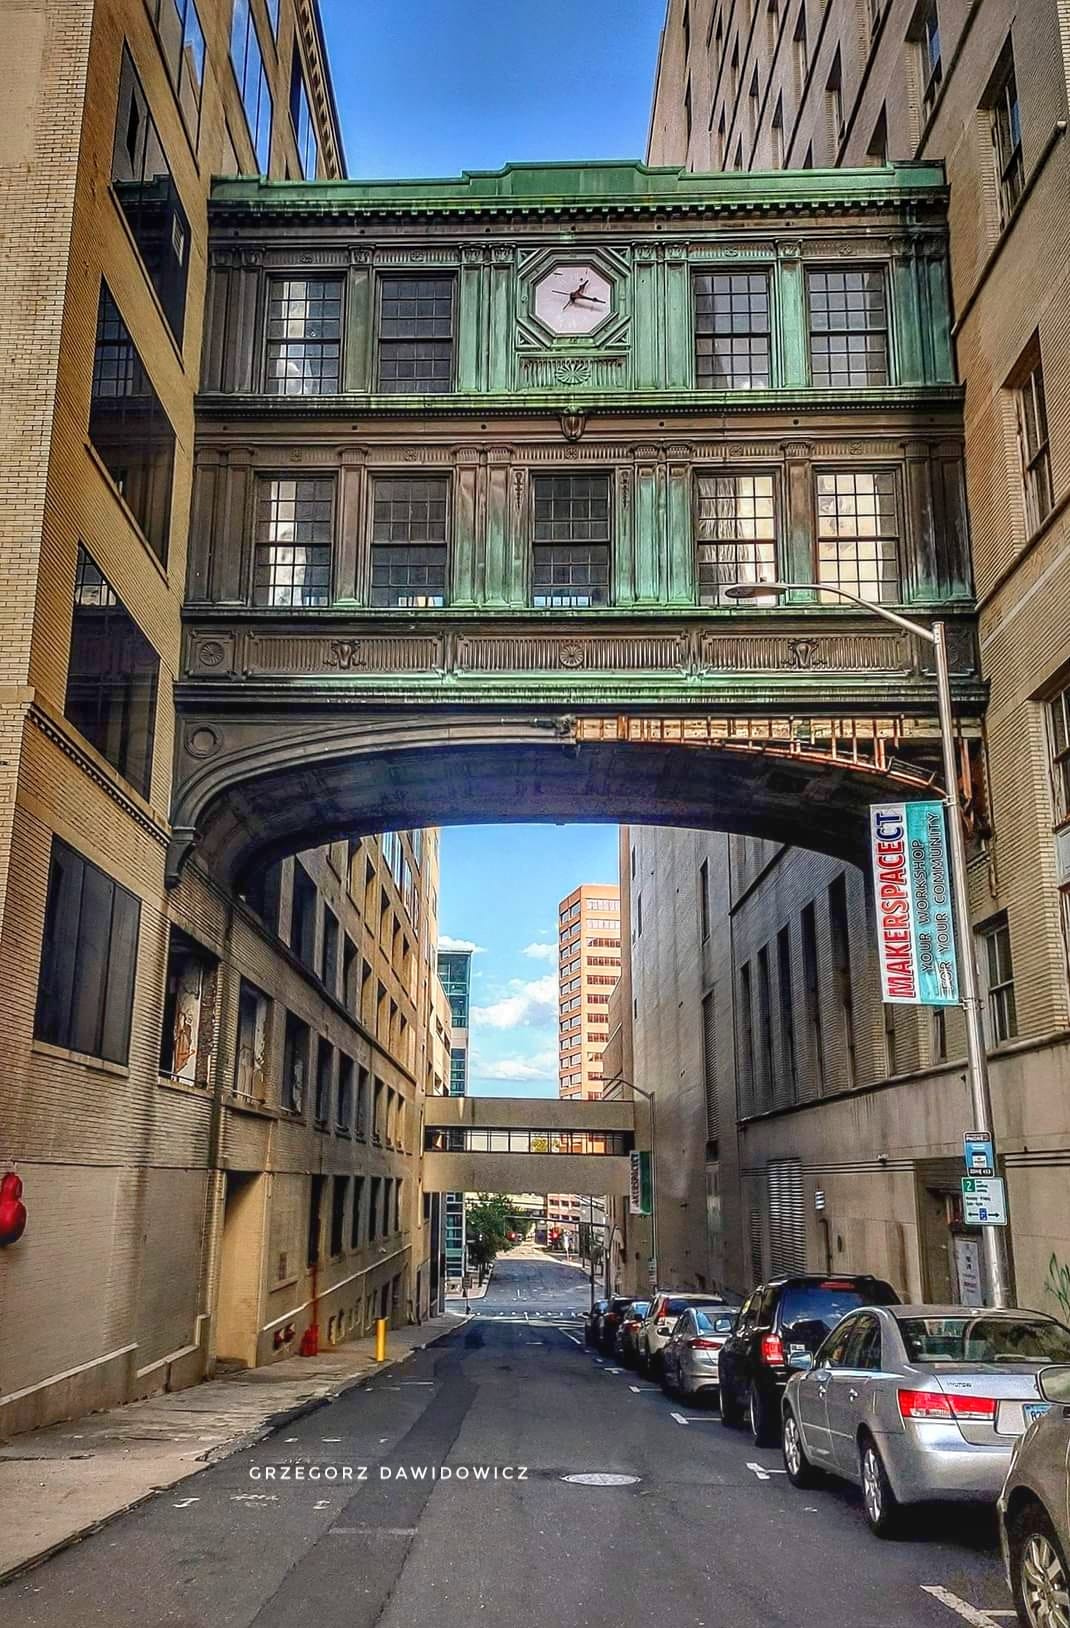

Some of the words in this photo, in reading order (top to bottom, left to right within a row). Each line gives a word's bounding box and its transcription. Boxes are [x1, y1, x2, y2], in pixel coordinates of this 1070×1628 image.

[911, 839, 929, 925] WORKSHOP
[927, 812, 946, 905] COMMUNITY
[876, 812, 917, 999] MAKERSPACECT
[936, 912, 949, 953] YOUR
[919, 932, 933, 972] YOUR
[966, 1180, 973, 1192] 2
